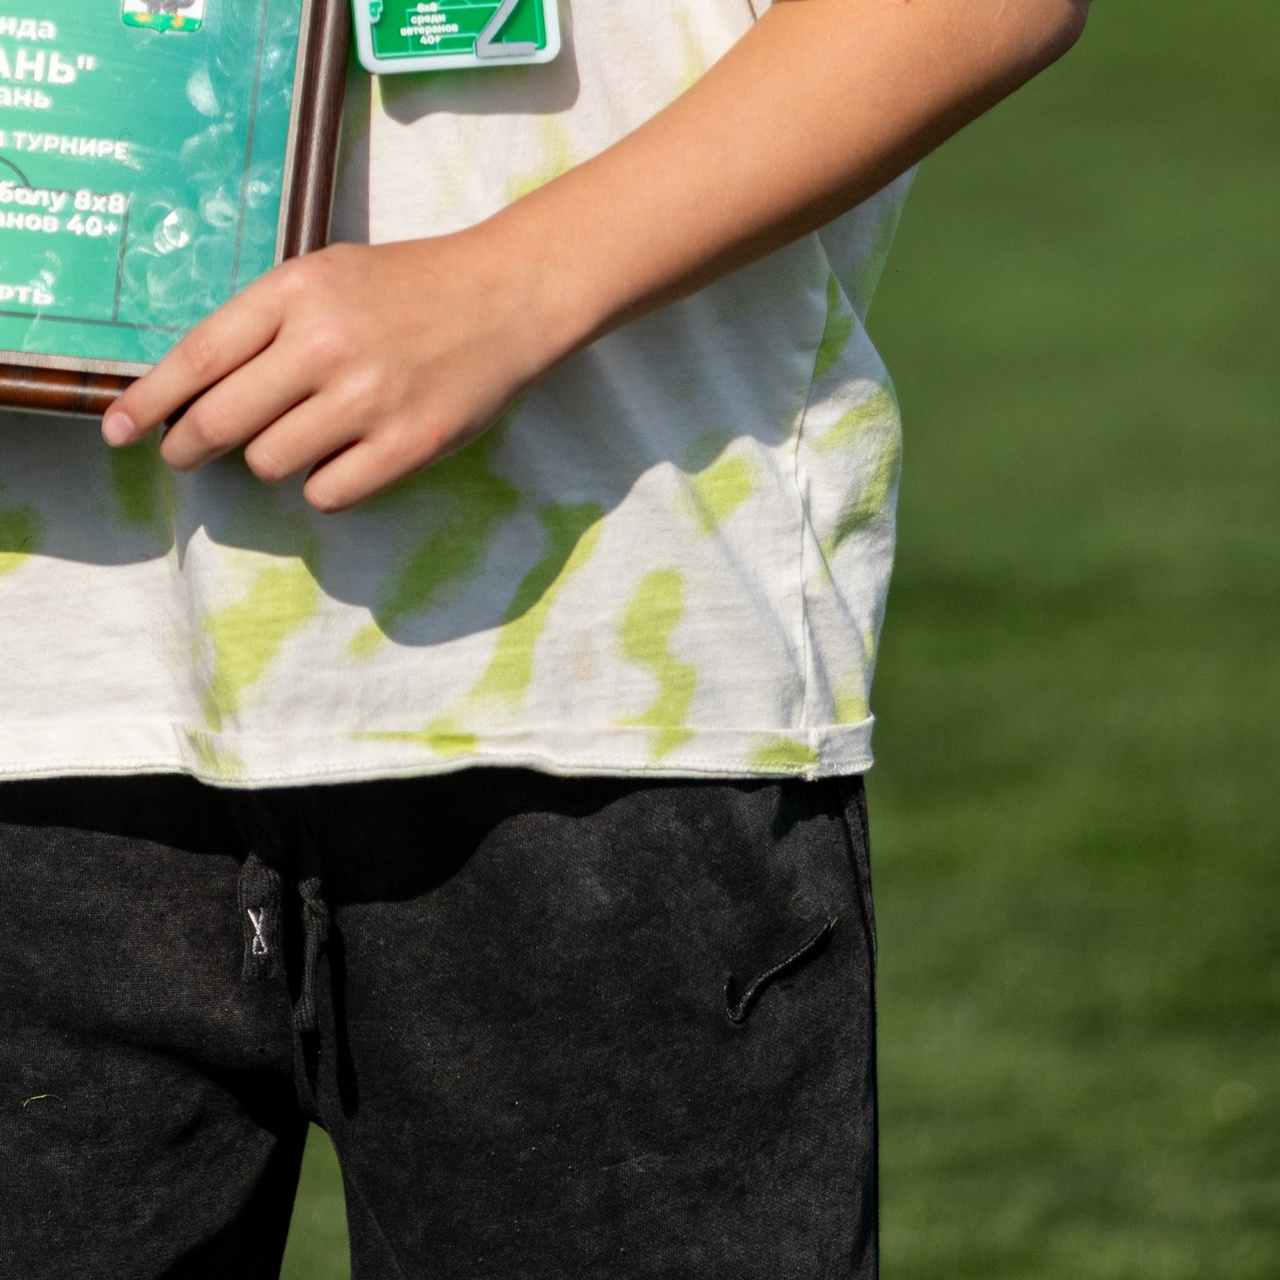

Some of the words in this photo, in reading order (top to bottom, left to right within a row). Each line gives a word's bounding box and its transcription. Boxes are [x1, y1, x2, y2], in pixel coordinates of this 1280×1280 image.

[410, 13, 446, 26] среди
[400, 23, 459, 36] ветеранов
[12, 130, 129, 161] ТУРНИРЕ
[66, 213, 118, 237] 40+
